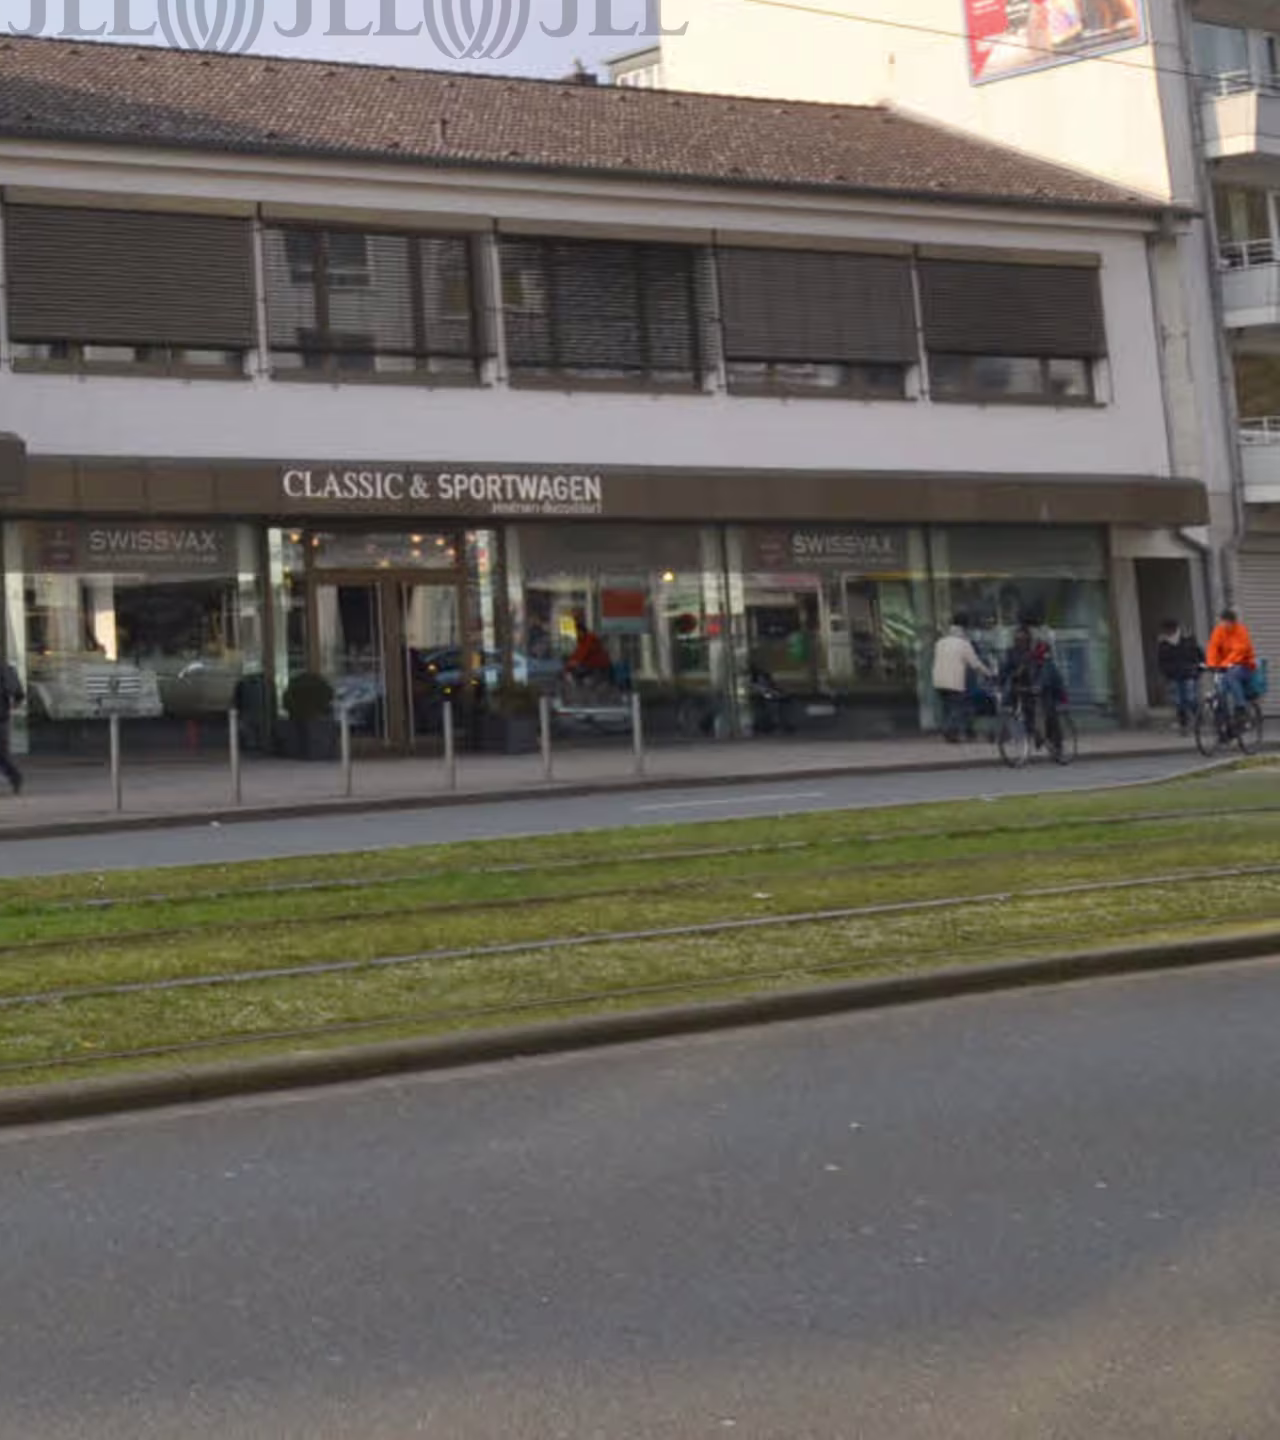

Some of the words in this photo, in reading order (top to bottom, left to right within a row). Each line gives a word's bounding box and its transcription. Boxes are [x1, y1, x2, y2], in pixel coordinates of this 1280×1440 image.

[283, 470, 404, 499] CLASSIC
[409, 472, 430, 499] &
[438, 473, 602, 501] SPORTWAGEN
[90, 528, 218, 552] SWISSVAX
